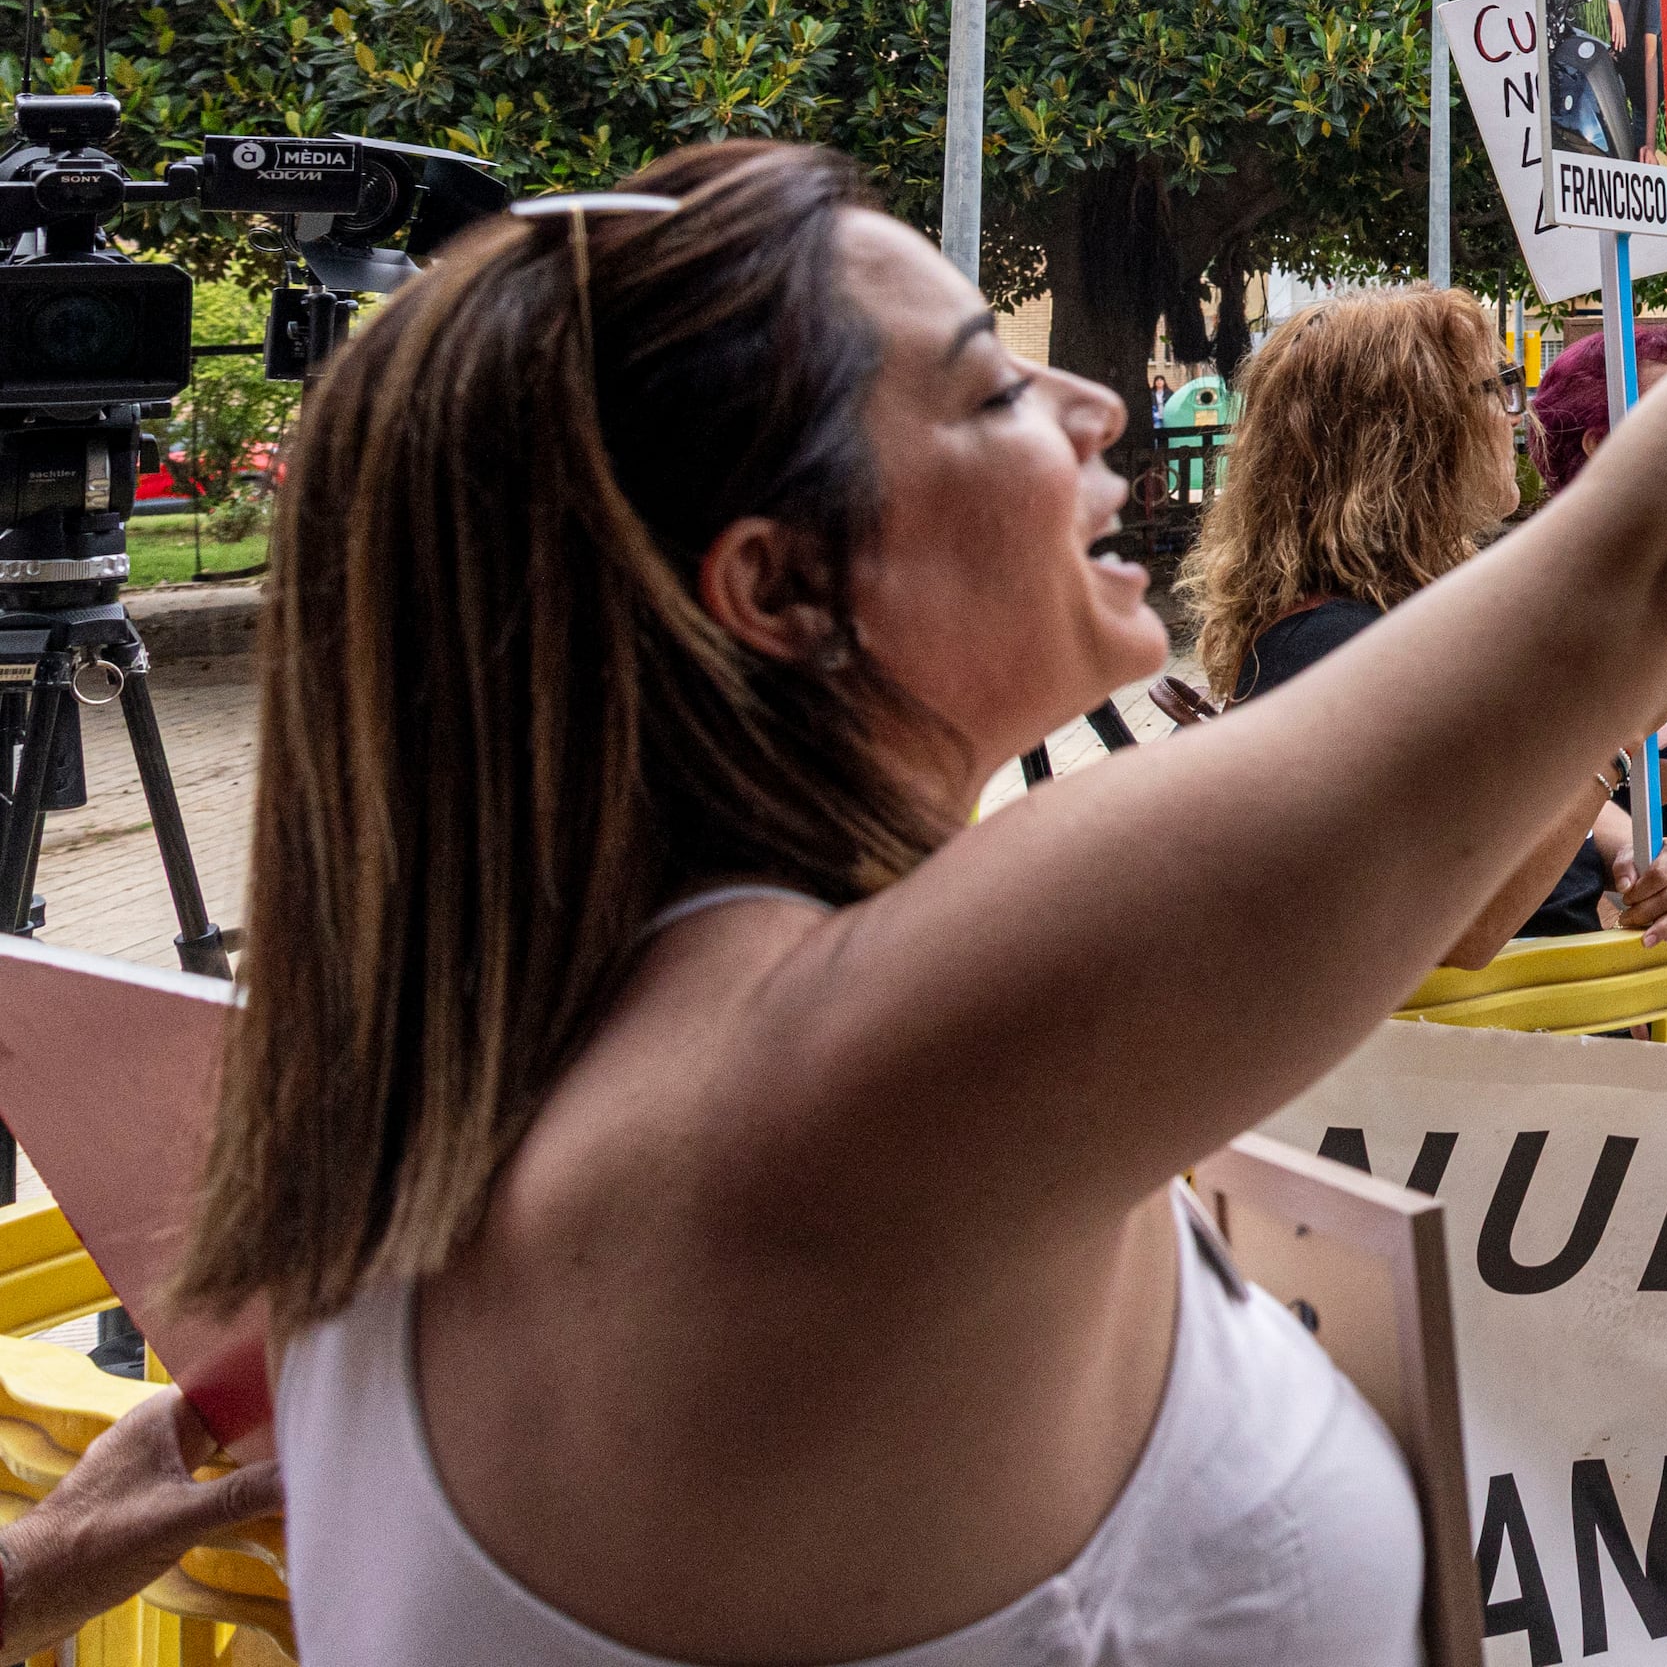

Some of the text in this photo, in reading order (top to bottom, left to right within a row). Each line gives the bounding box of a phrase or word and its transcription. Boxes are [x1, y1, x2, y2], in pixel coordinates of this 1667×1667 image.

[284, 149, 346, 166] MÈDIA
[61, 175, 100, 183] SONY
[257, 170, 322, 181] XDCAM
[1560, 163, 1667, 225] FRANCISCO
